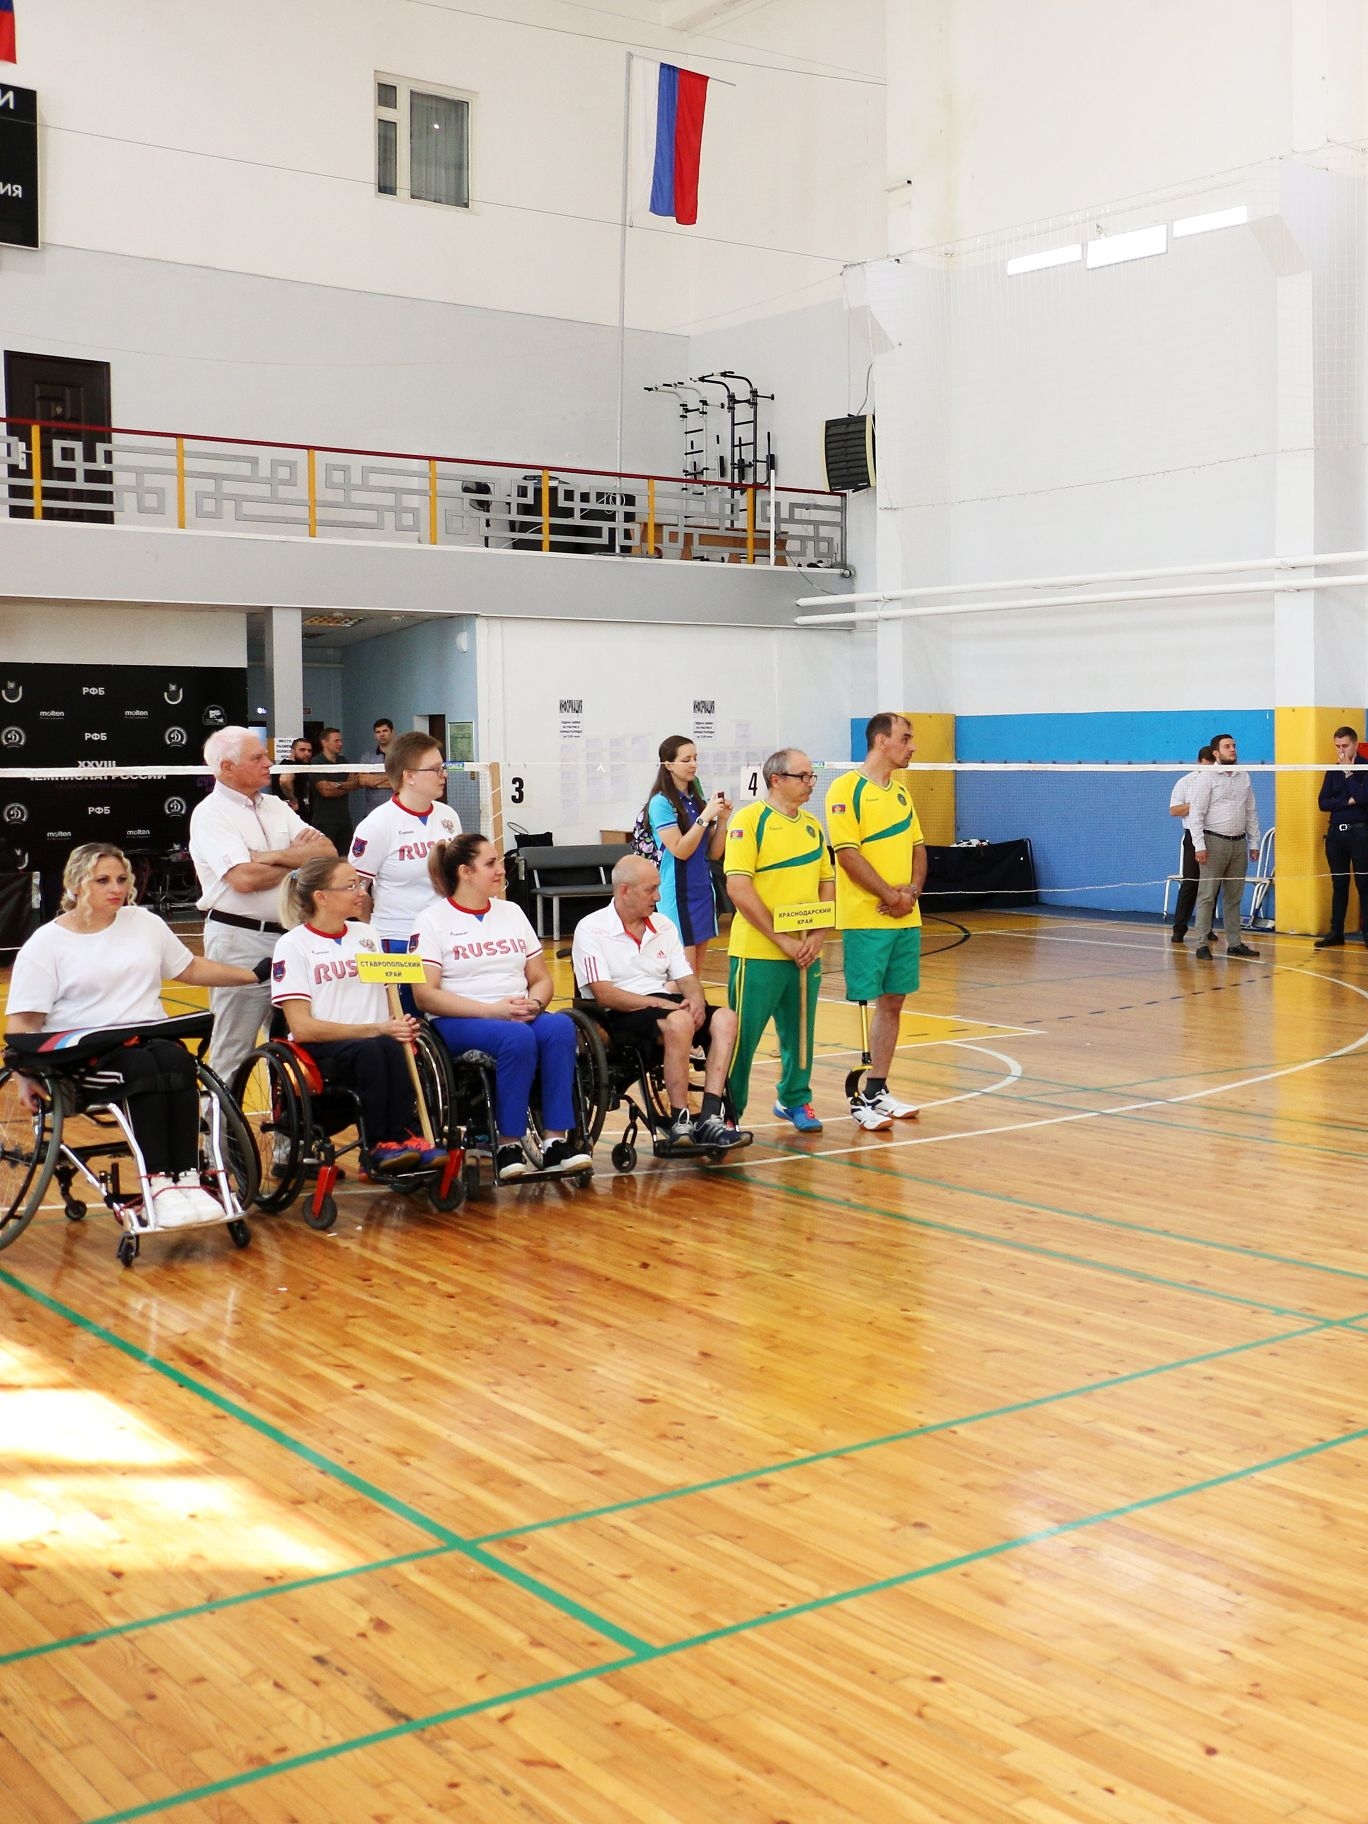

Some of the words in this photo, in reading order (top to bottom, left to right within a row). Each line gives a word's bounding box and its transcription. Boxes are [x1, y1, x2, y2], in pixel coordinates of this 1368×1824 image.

[82, 687, 105, 695] РФБ
[125, 709, 148, 717] molten
[85, 732, 107, 741] РФБ
[748, 772, 758, 796] 4
[511, 777, 524, 804] 3
[88, 806, 111, 815] РФБ
[47, 830, 71, 838] molten
[778, 906, 832, 918] КРАСНОДАРСКИЙ
[453, 938, 527, 961] RUSSIA
[360, 960, 421, 968] СТАВРОПОЛЬСКИЙ
[385, 970, 402, 978] КРАЙ
